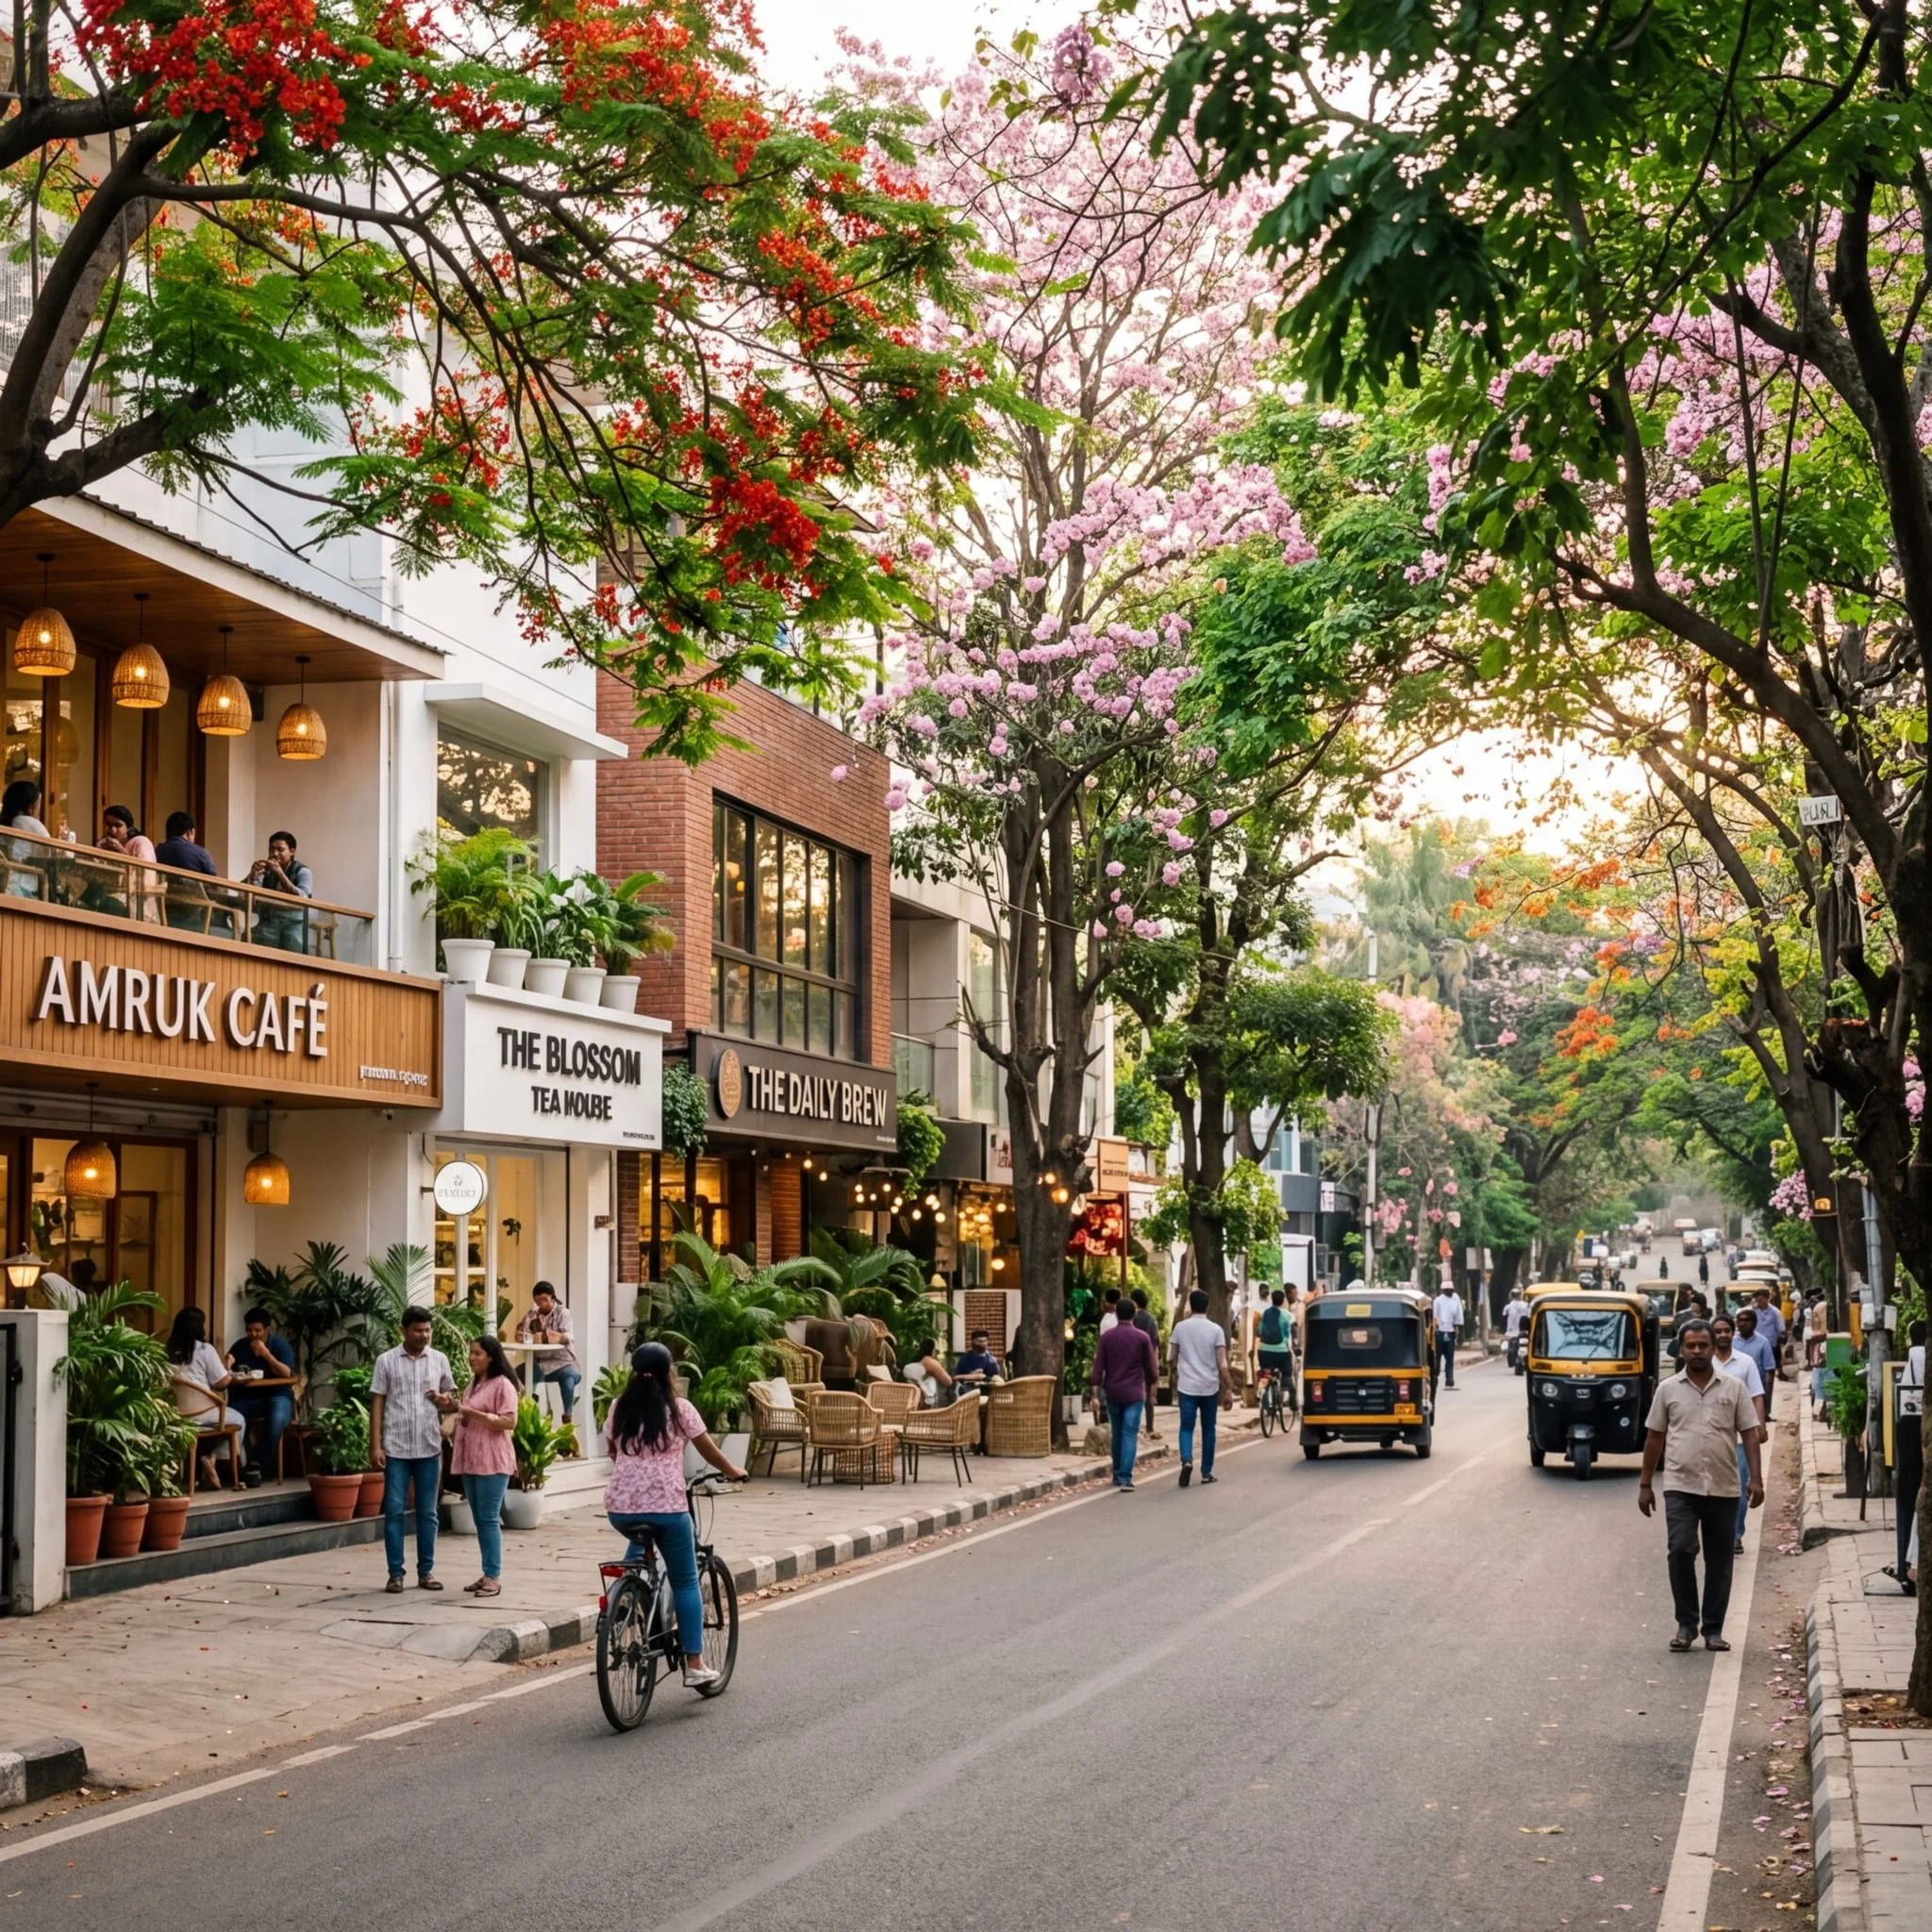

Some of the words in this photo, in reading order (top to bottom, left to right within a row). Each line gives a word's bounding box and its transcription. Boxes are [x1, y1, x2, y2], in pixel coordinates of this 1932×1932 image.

[38, 956, 216, 1042] AMRUK
[227, 983, 328, 1057] CAFÉ
[497, 1026, 541, 1071] THE
[546, 1036, 641, 1085] BLOSSOM
[531, 1086, 561, 1114] TEA
[748, 1066, 786, 1113] THE
[789, 1073, 839, 1120] DAILY
[841, 1082, 888, 1126] BREW
